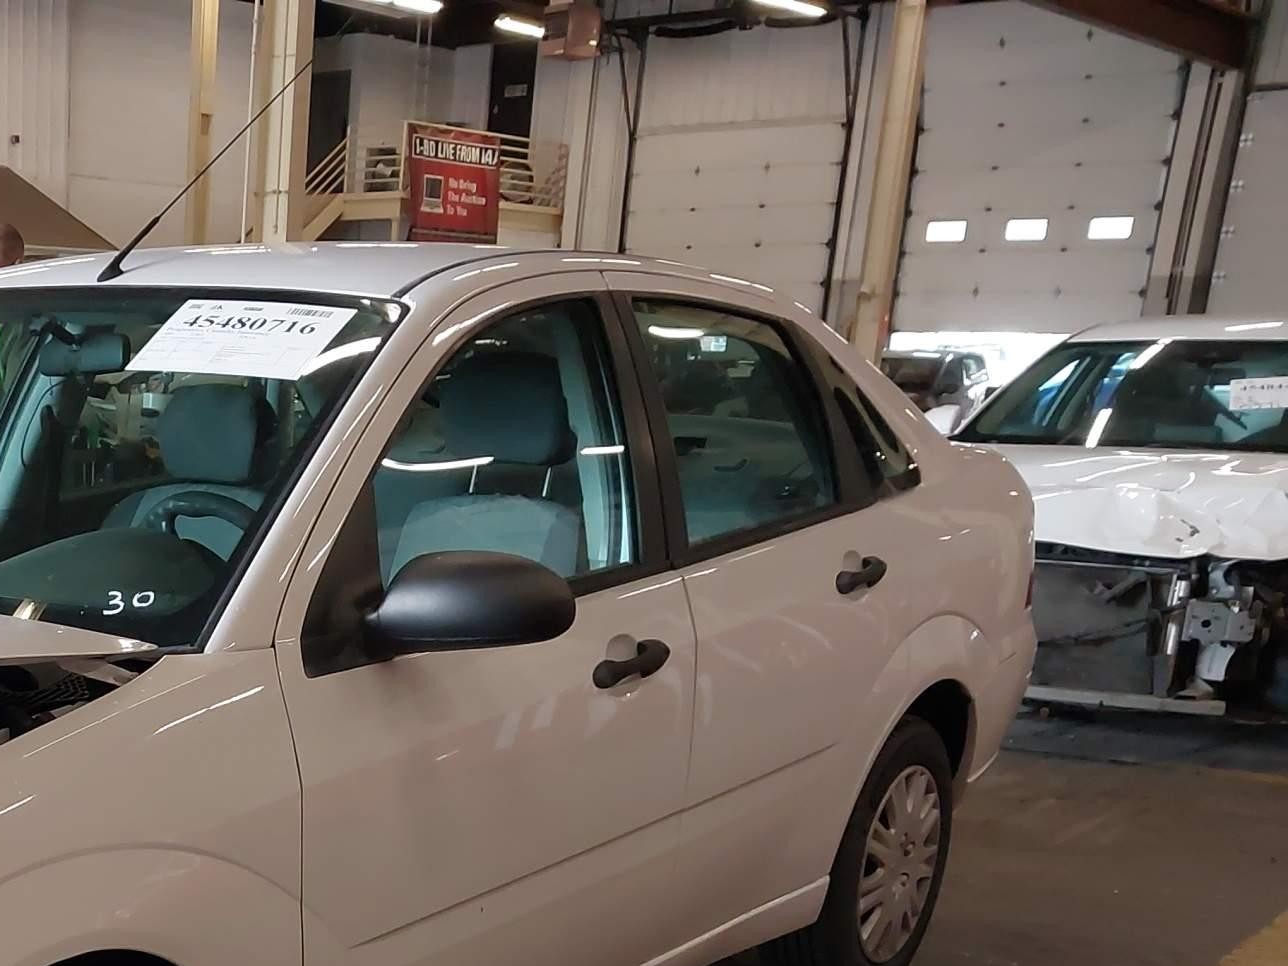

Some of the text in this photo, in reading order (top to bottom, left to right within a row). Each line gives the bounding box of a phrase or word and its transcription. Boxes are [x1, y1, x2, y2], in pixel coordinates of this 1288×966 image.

[438, 142, 456, 160] LIVE
[456, 145, 480, 164] FROM
[460, 192, 486, 206] Auction
[183, 314, 317, 335] 45480716
[102, 590, 155, 615] 30
